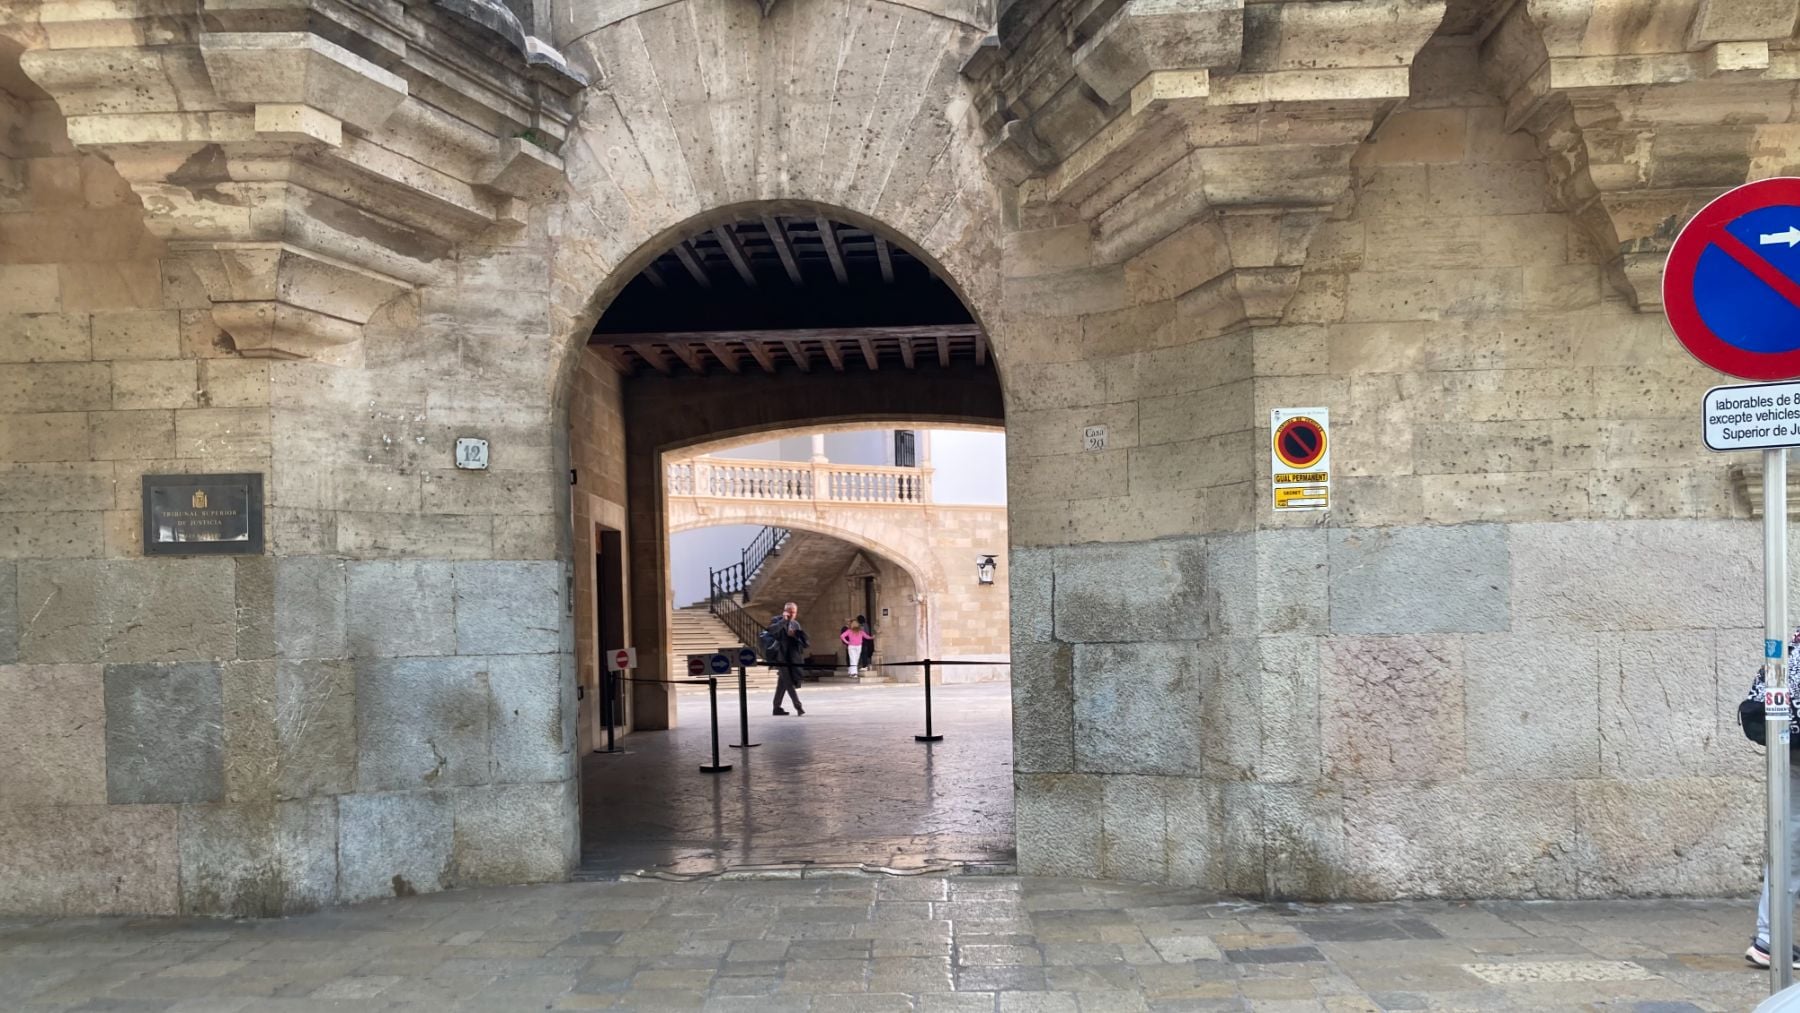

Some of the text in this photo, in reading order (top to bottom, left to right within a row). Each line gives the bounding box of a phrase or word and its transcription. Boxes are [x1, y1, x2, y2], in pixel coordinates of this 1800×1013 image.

[1716, 396, 1773, 411] laborables
[1776, 394, 1791, 405] de
[1709, 408, 1800, 425] excepte vehicles
[1723, 427, 1770, 441] Superior
[1773, 424, 1787, 436] de
[463, 444, 481, 462] 12
[1275, 473, 1326, 483] GUAL PERMANENT
